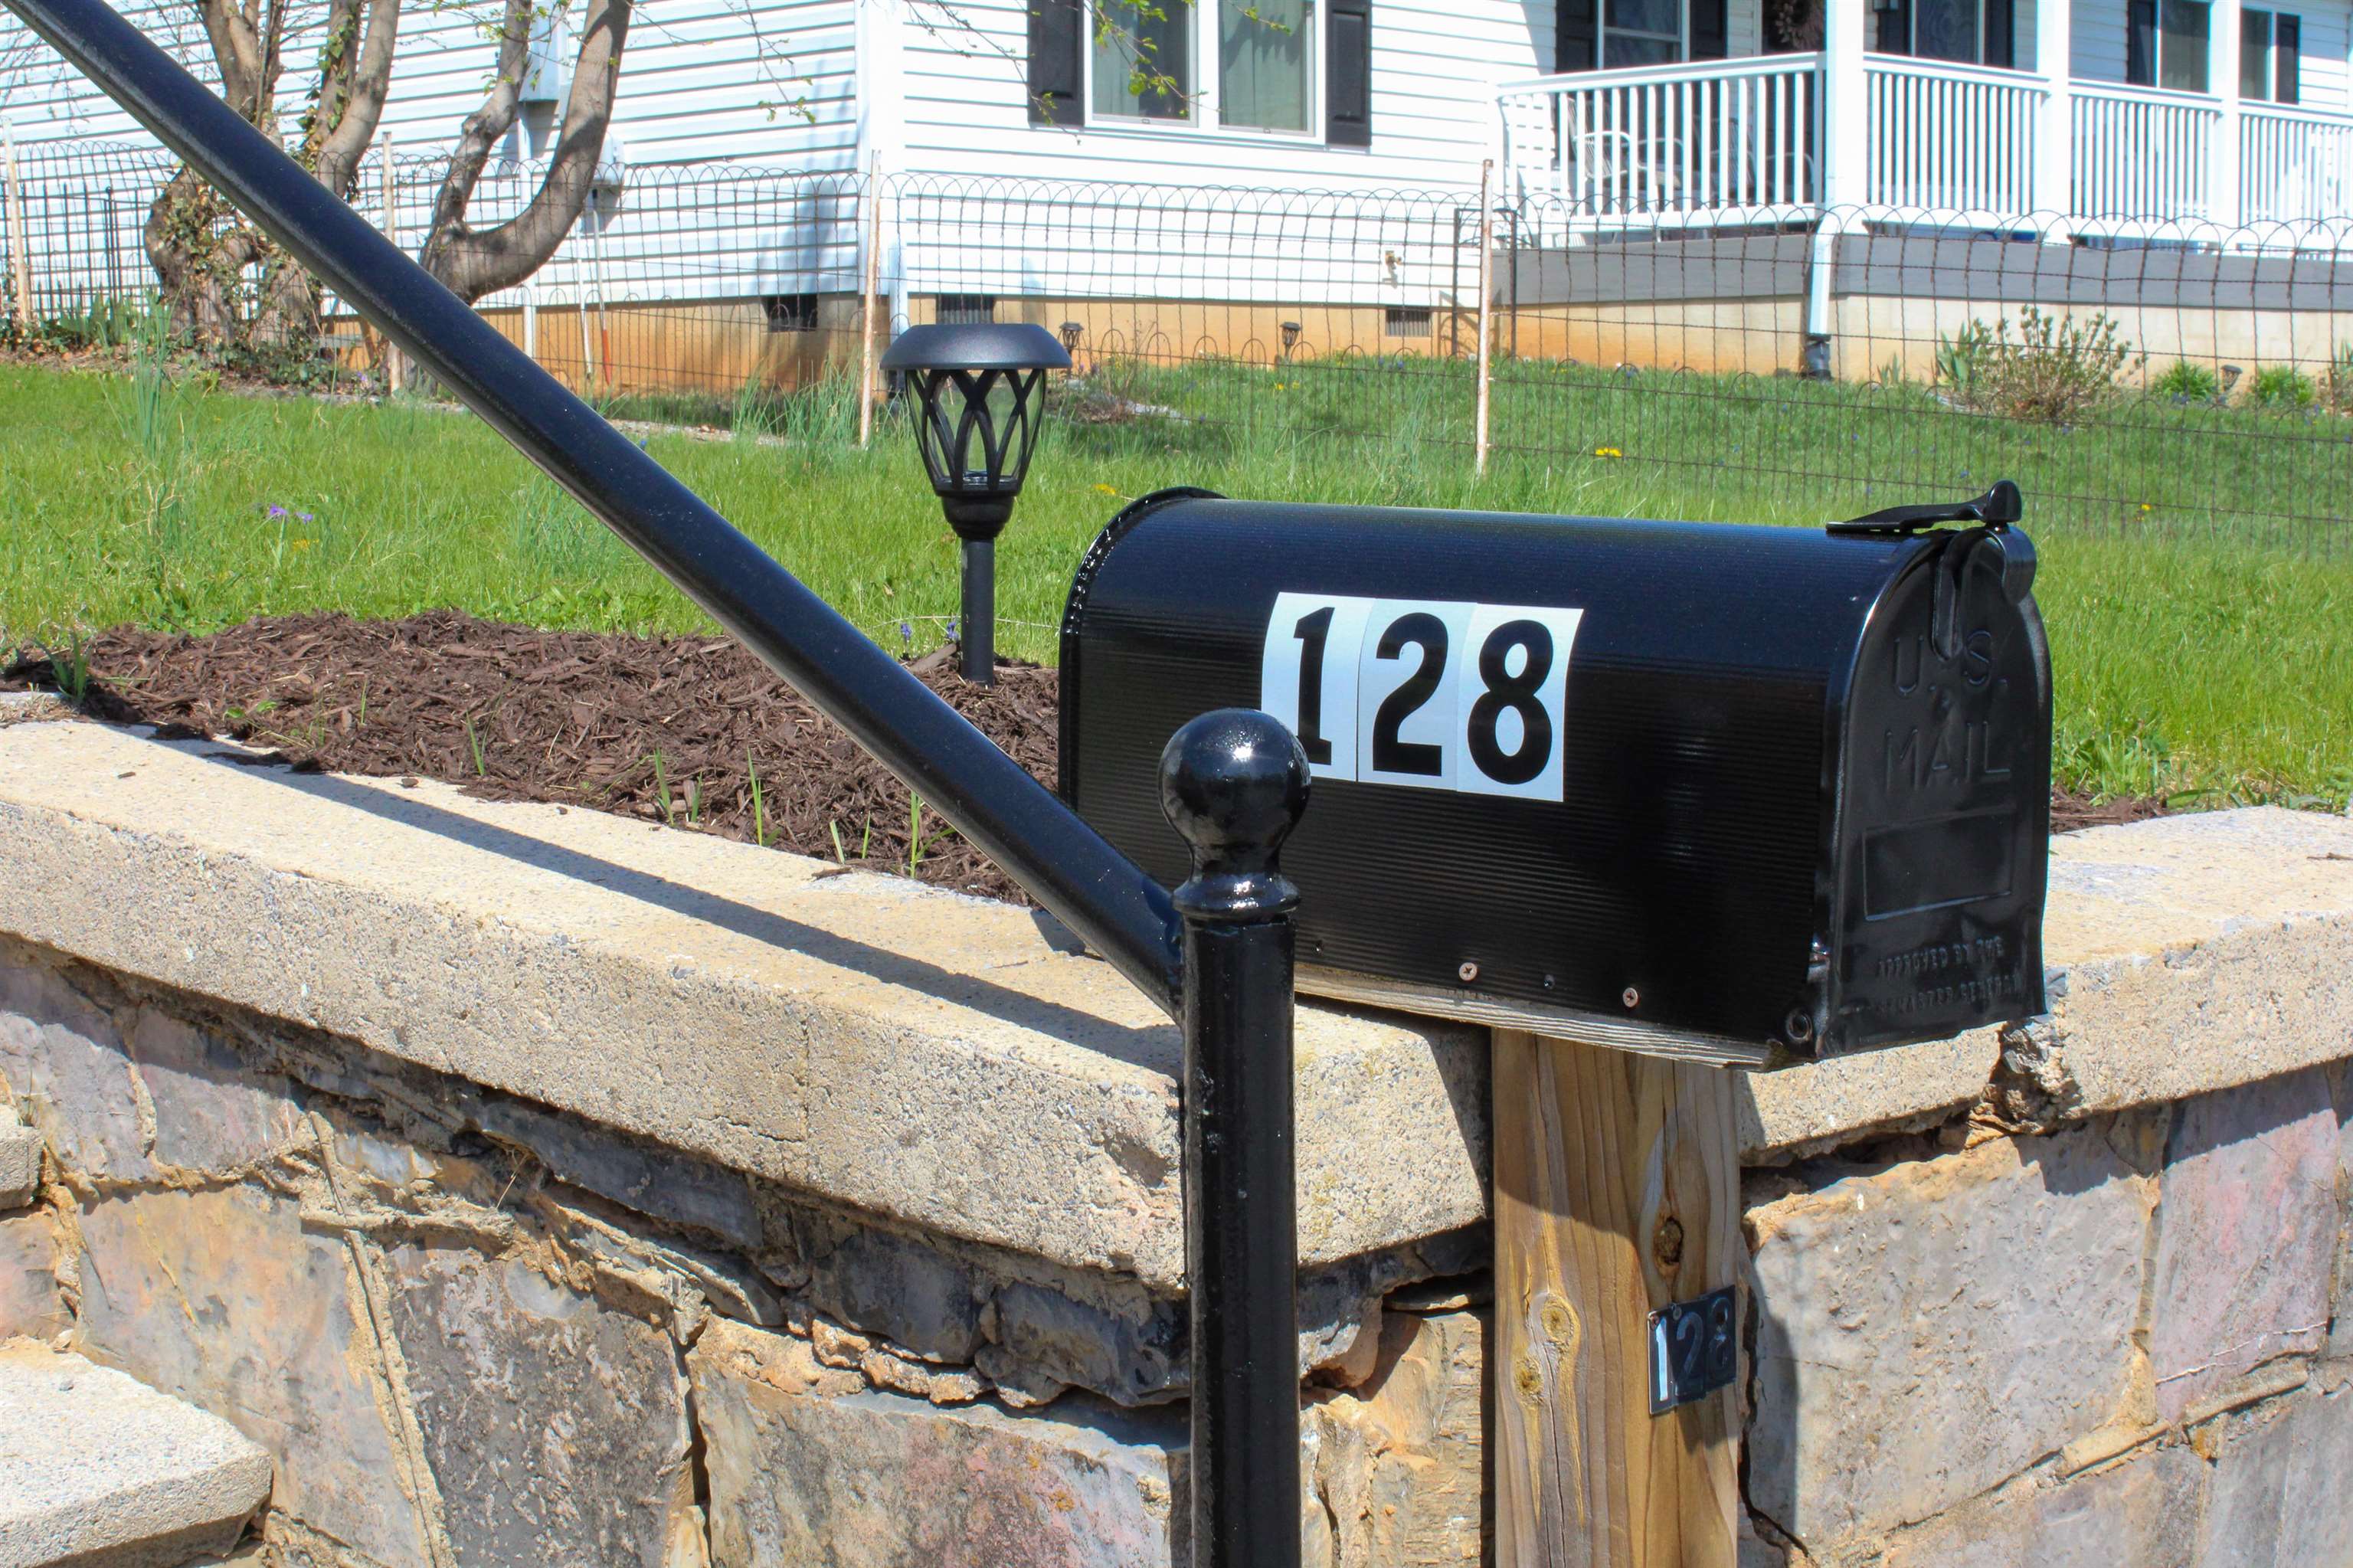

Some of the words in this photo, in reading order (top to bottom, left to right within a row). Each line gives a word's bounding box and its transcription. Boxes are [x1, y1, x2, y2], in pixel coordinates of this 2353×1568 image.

[1292, 606, 1554, 785] 128
[1882, 721, 2013, 792] MAIL
[1879, 946, 1949, 980] APPROVED
[1655, 1298, 1733, 1402] 128
